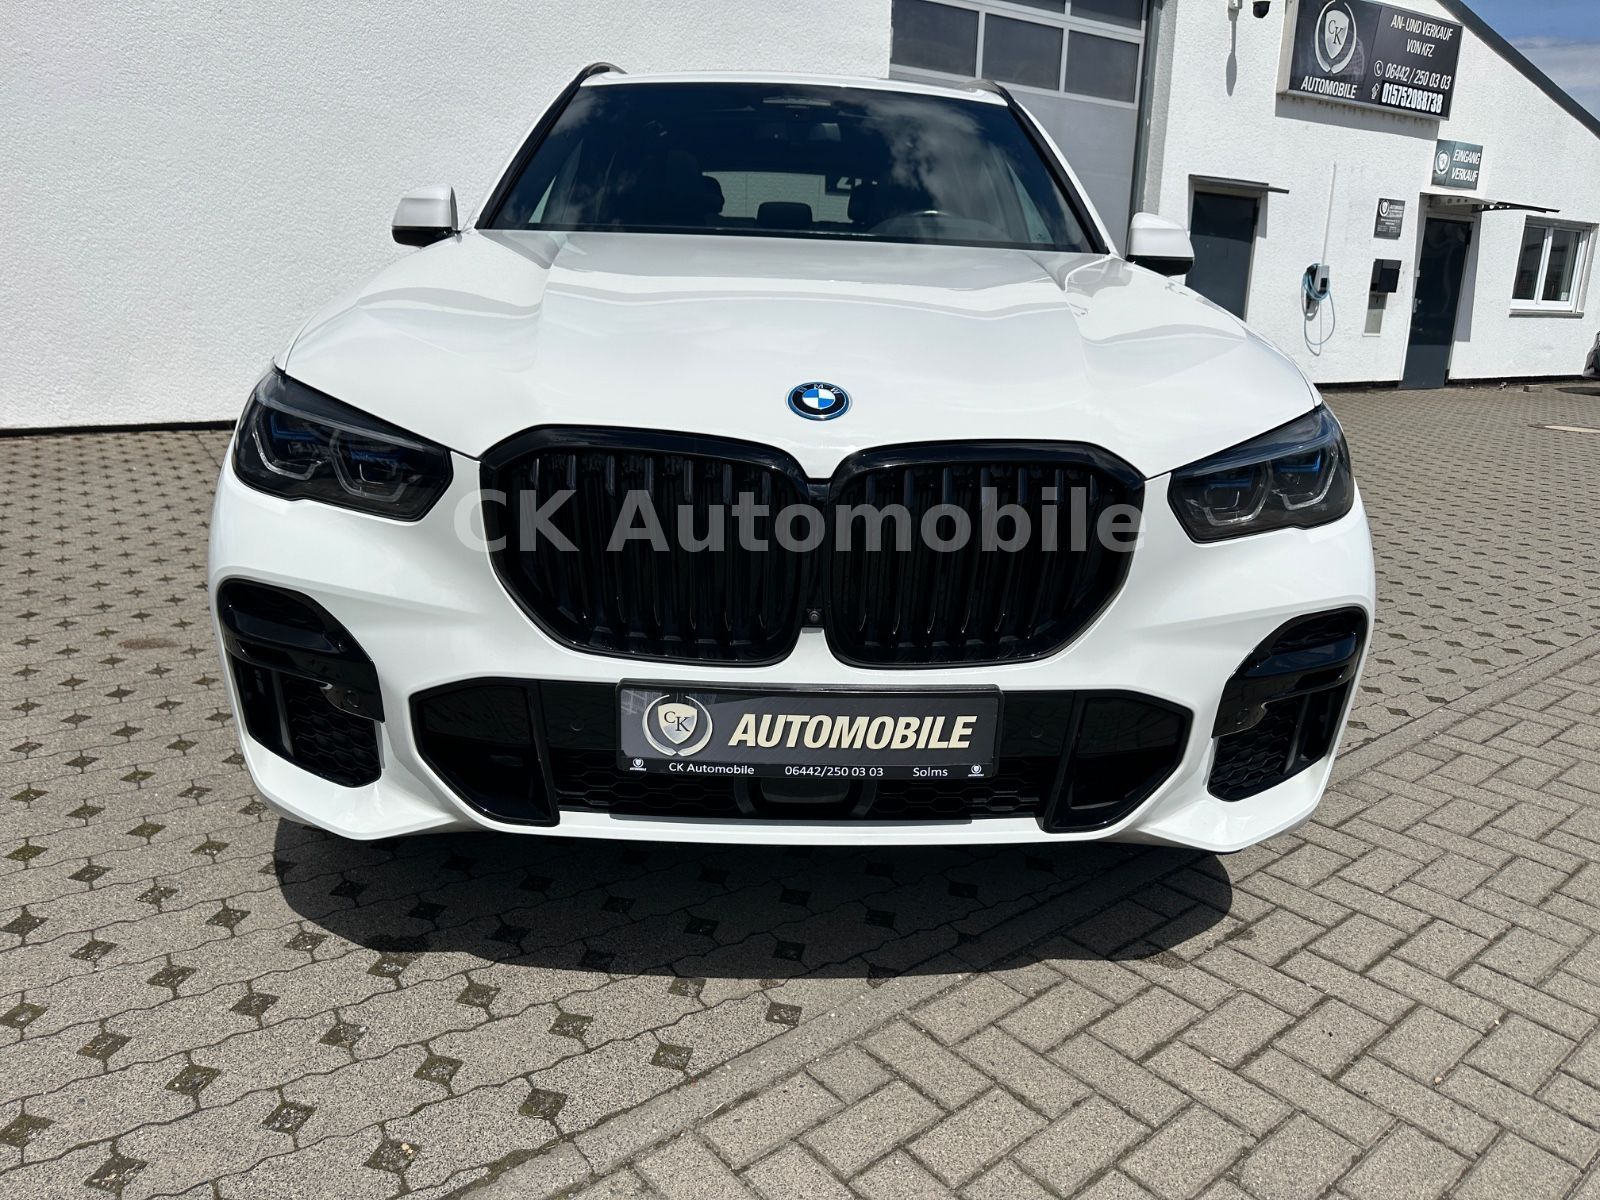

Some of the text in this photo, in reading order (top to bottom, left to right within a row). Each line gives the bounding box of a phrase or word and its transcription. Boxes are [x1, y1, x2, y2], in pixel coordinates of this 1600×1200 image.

[1405, 18, 1422, 34] UND
[1422, 22, 1453, 41] VERKAUF
[1406, 38, 1435, 58] VON KFZ
[1385, 63, 1410, 82] 06442
[1413, 69, 1429, 86] 250
[1429, 73, 1440, 88] 03
[1440, 75, 1452, 90] 03
[1300, 76, 1358, 99] AUTOMOBILE
[1382, 82, 1444, 114] 015752088738
[1453, 150, 1480, 164] EINGANG
[1452, 167, 1478, 182] VERKAUF
[664, 710, 690, 732] CK
[728, 713, 978, 750] AUTOMOBILE
[668, 762, 754, 774] CK Automobile
[784, 765, 884, 778] 06442/250 03 03
[912, 766, 948, 777] Solms
